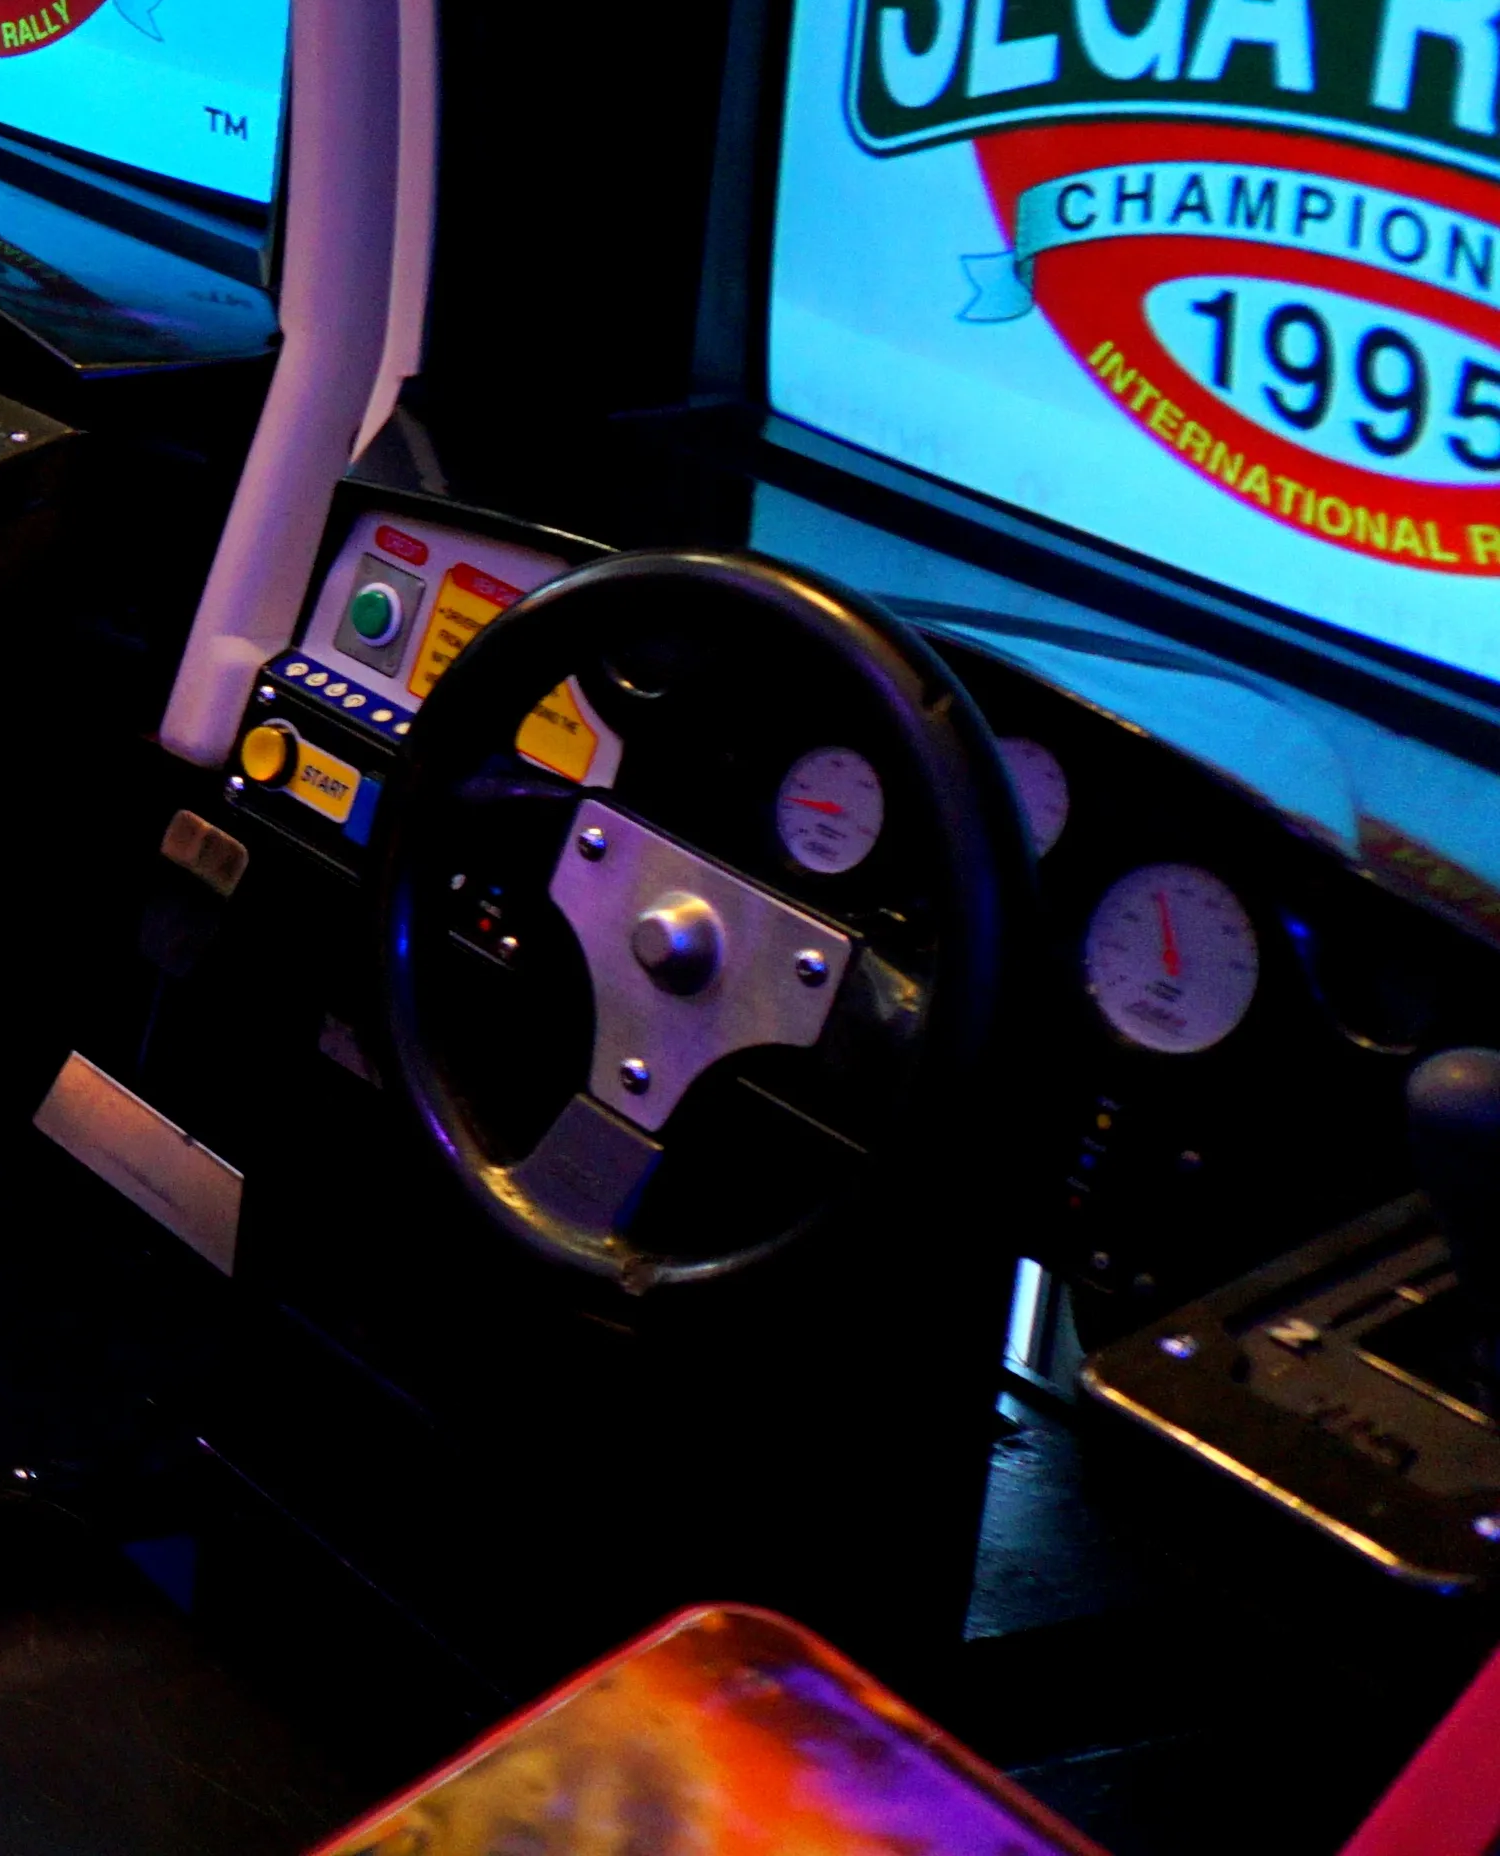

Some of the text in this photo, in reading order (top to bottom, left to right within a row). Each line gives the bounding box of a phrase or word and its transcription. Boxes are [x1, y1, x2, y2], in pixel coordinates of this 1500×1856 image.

[205, 105, 248, 140] TM
[1085, 340, 1458, 567] INTERNATIONAL
[300, 764, 350, 802] START
